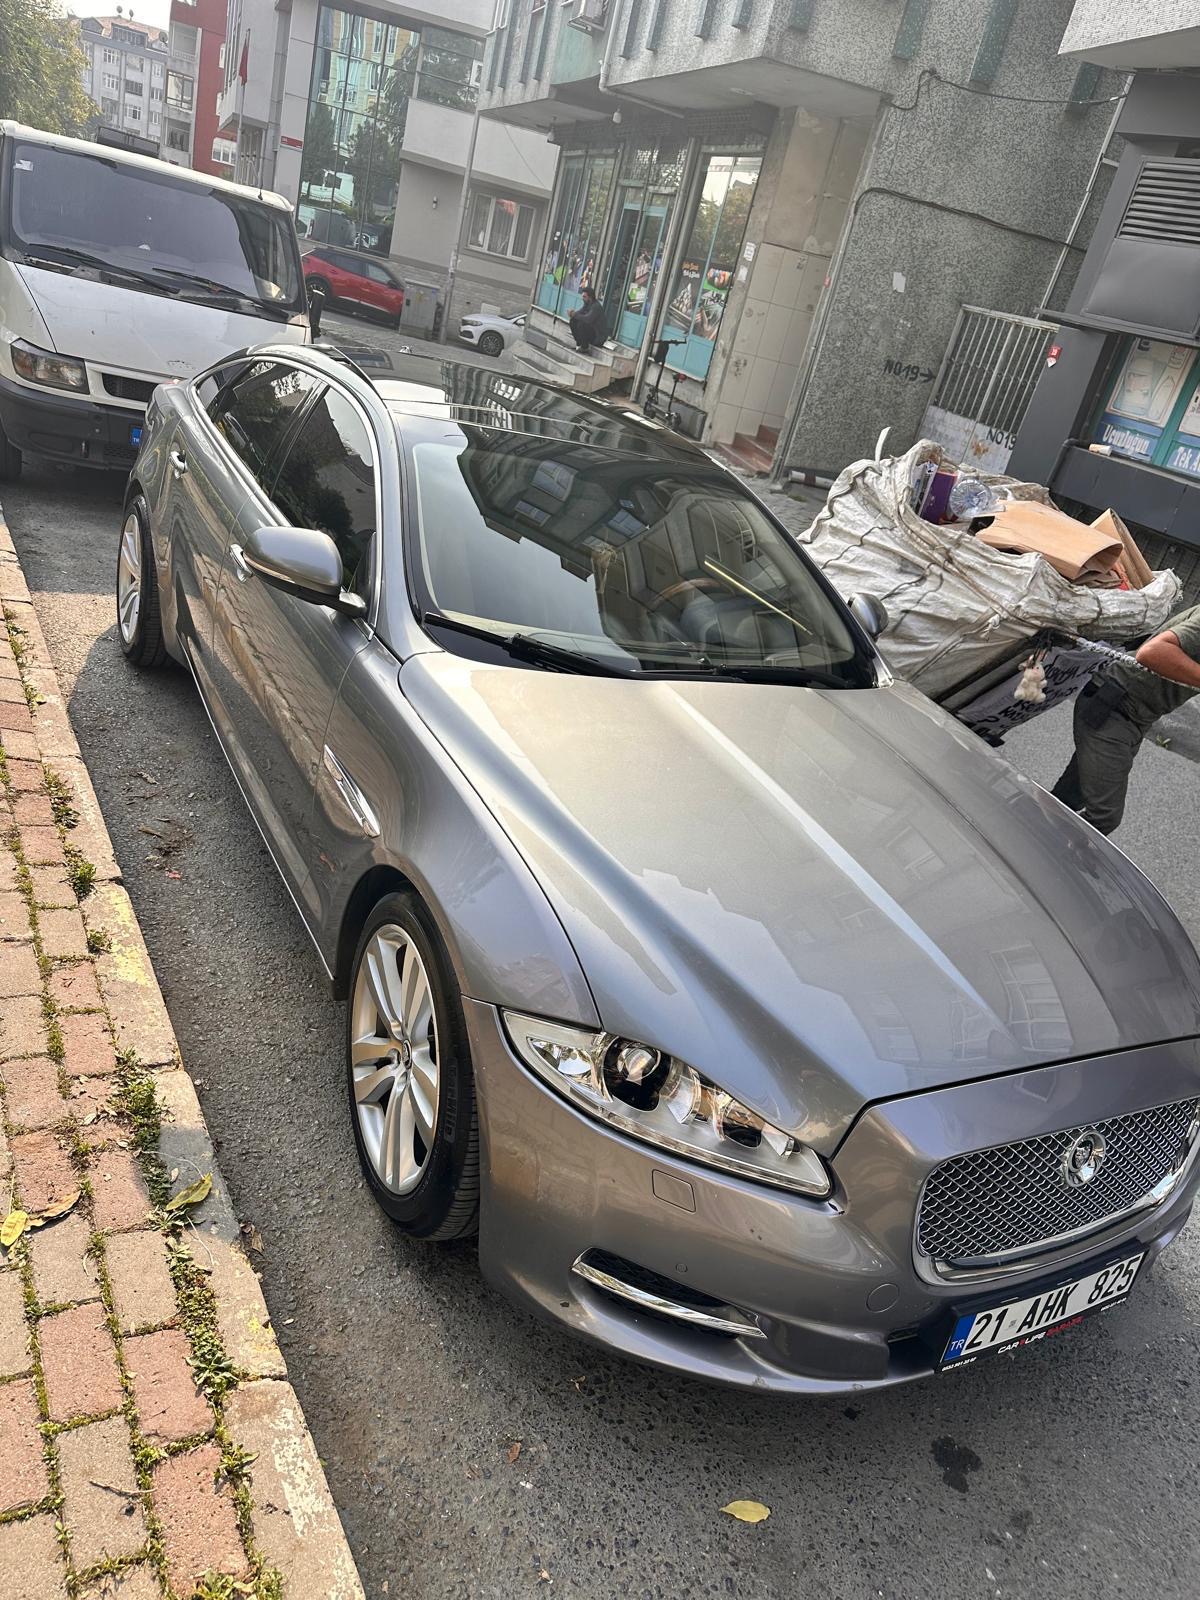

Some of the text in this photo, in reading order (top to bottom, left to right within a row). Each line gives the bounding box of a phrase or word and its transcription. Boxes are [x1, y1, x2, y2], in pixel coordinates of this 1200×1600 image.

[1173, 446, 1193, 469] Tek
[950, 1256, 1141, 1351] TR 21 AHK 825
